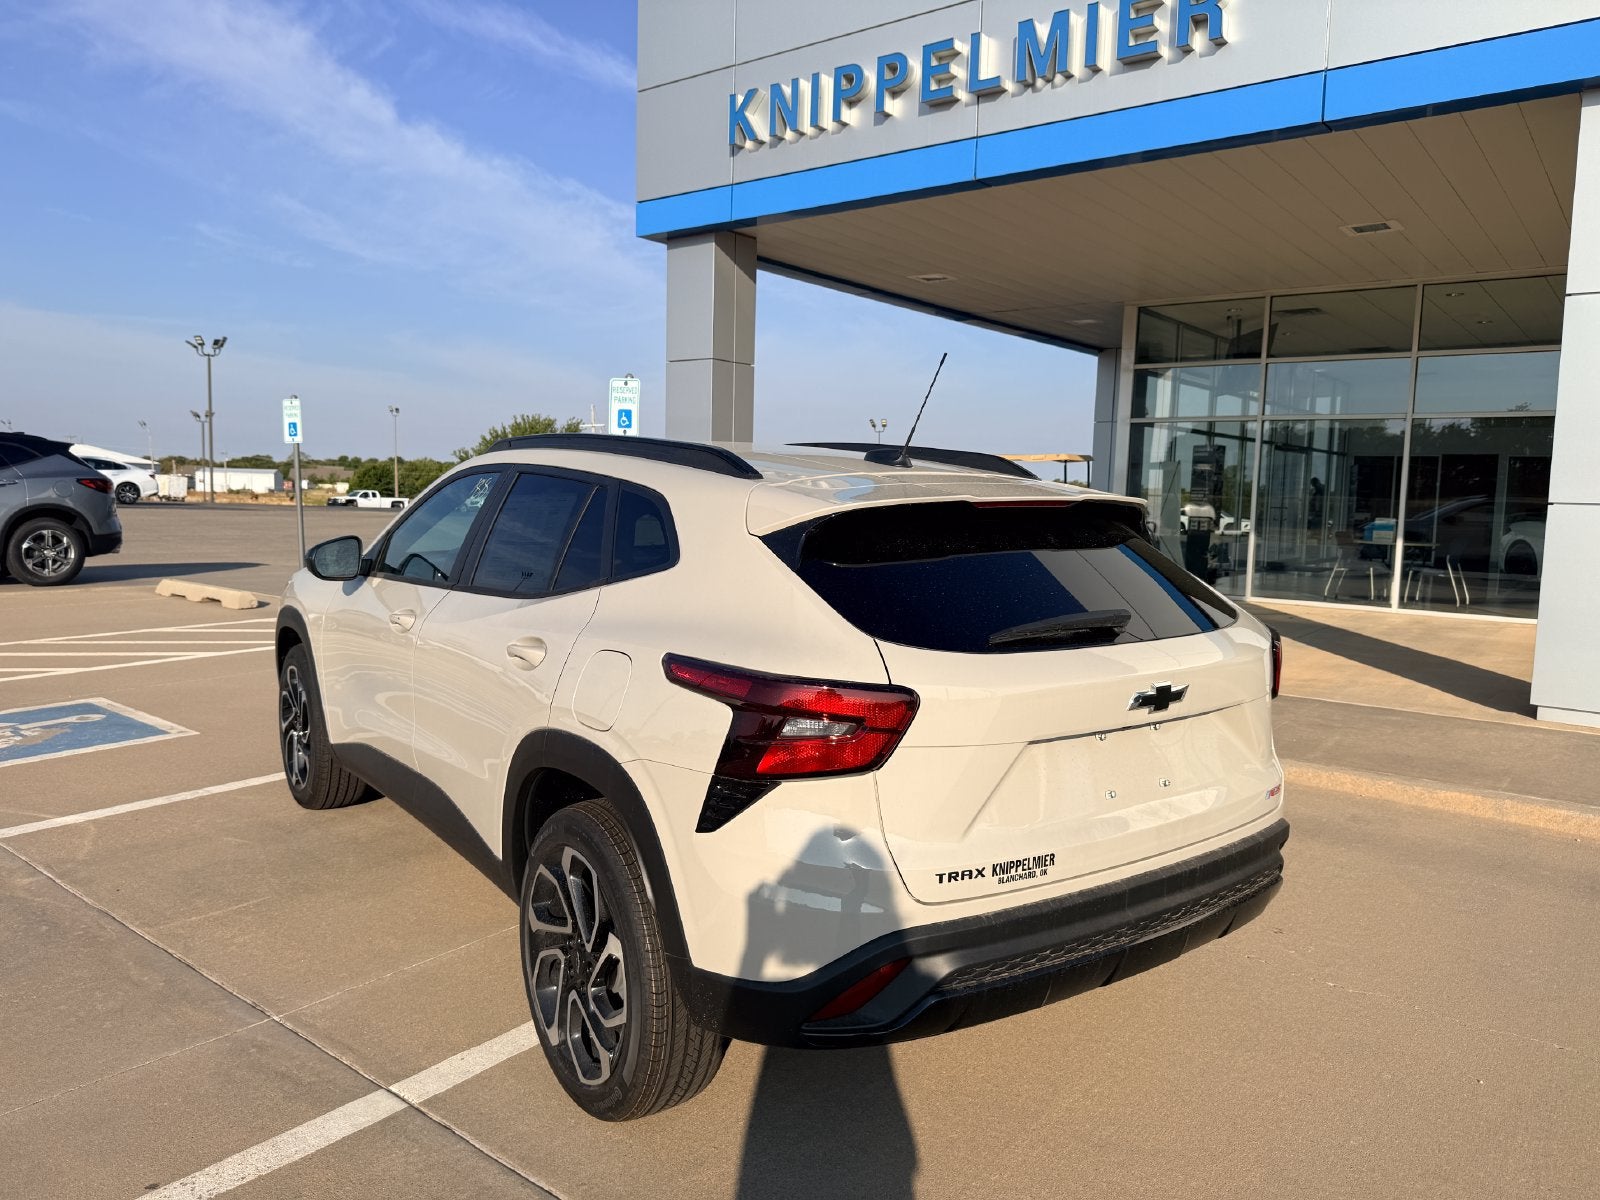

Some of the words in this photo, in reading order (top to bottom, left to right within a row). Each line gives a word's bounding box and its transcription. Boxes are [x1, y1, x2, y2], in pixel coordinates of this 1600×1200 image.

[728, 0, 1225, 147] KNIPPELMIER
[613, 396, 636, 404] PARKING
[991, 853, 1056, 878] KNIPPELMIER
[1039, 868, 1048, 877] OK
[935, 867, 986, 884] TRAX
